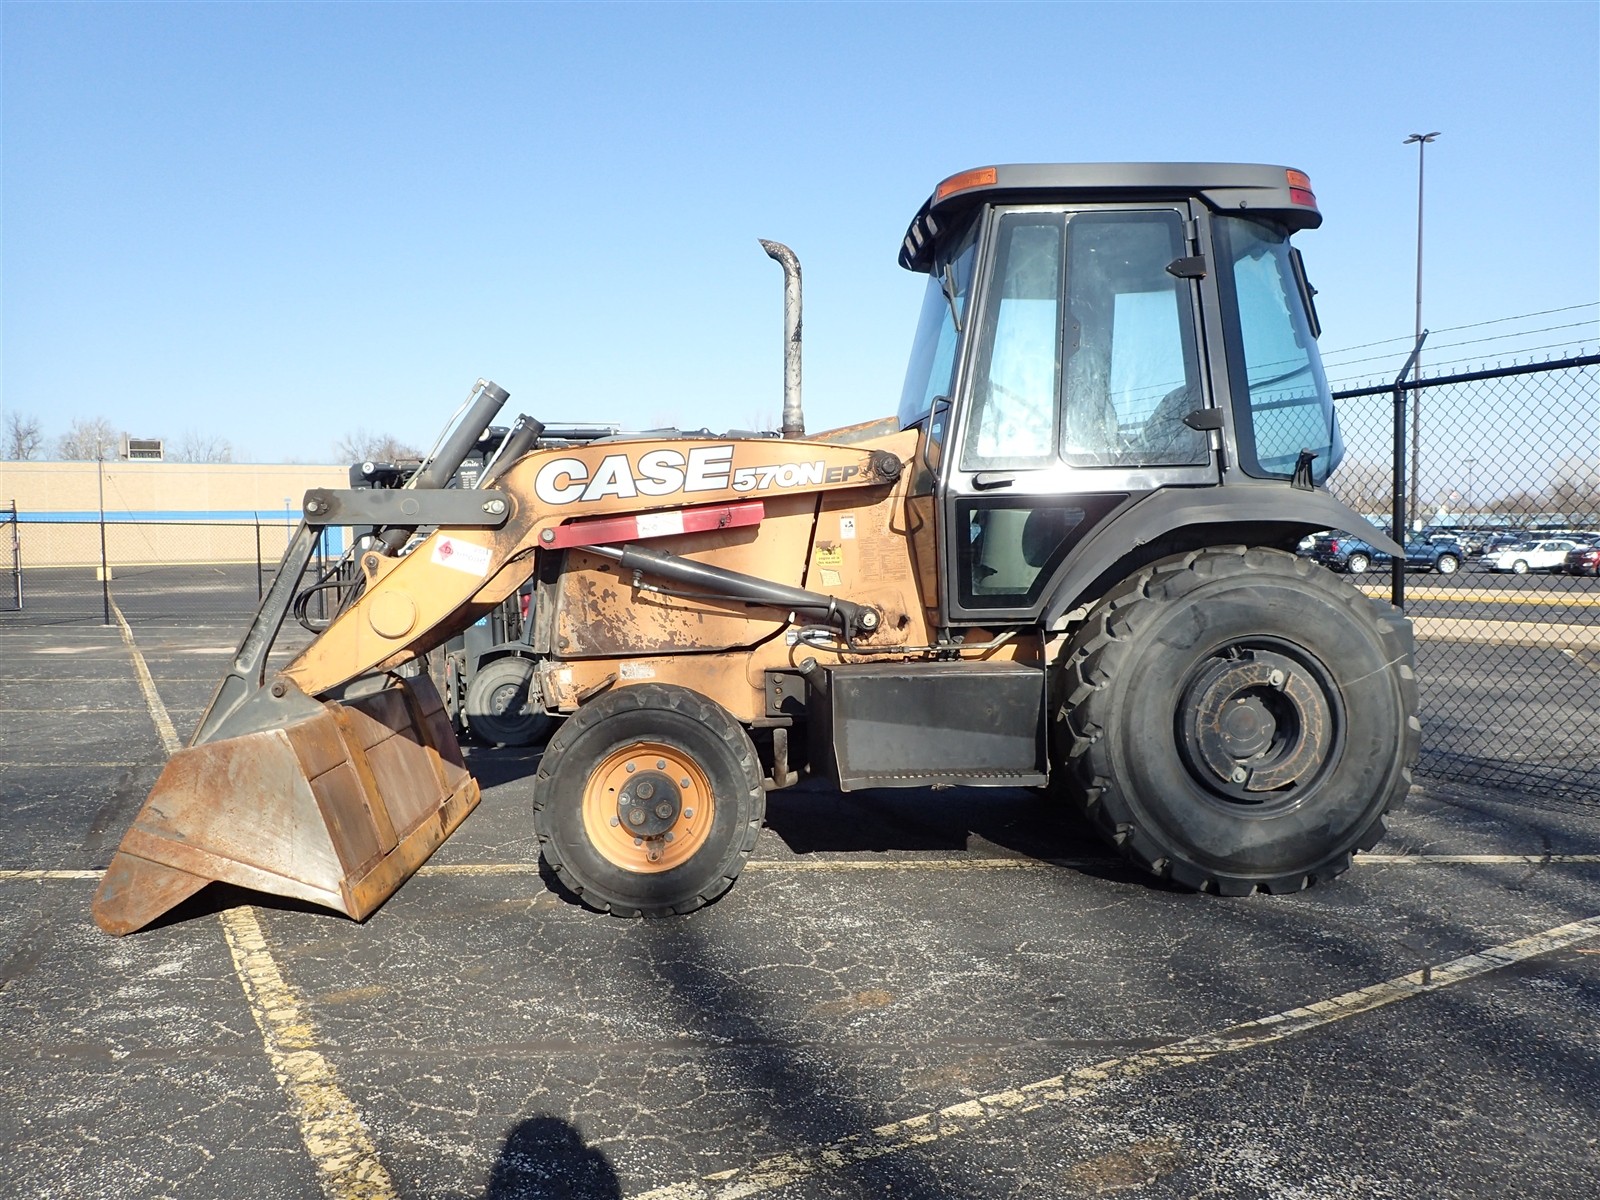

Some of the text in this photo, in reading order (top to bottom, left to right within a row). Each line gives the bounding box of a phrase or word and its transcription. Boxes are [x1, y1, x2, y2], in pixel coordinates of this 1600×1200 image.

[535, 445, 859, 505] CASE 570N EP
